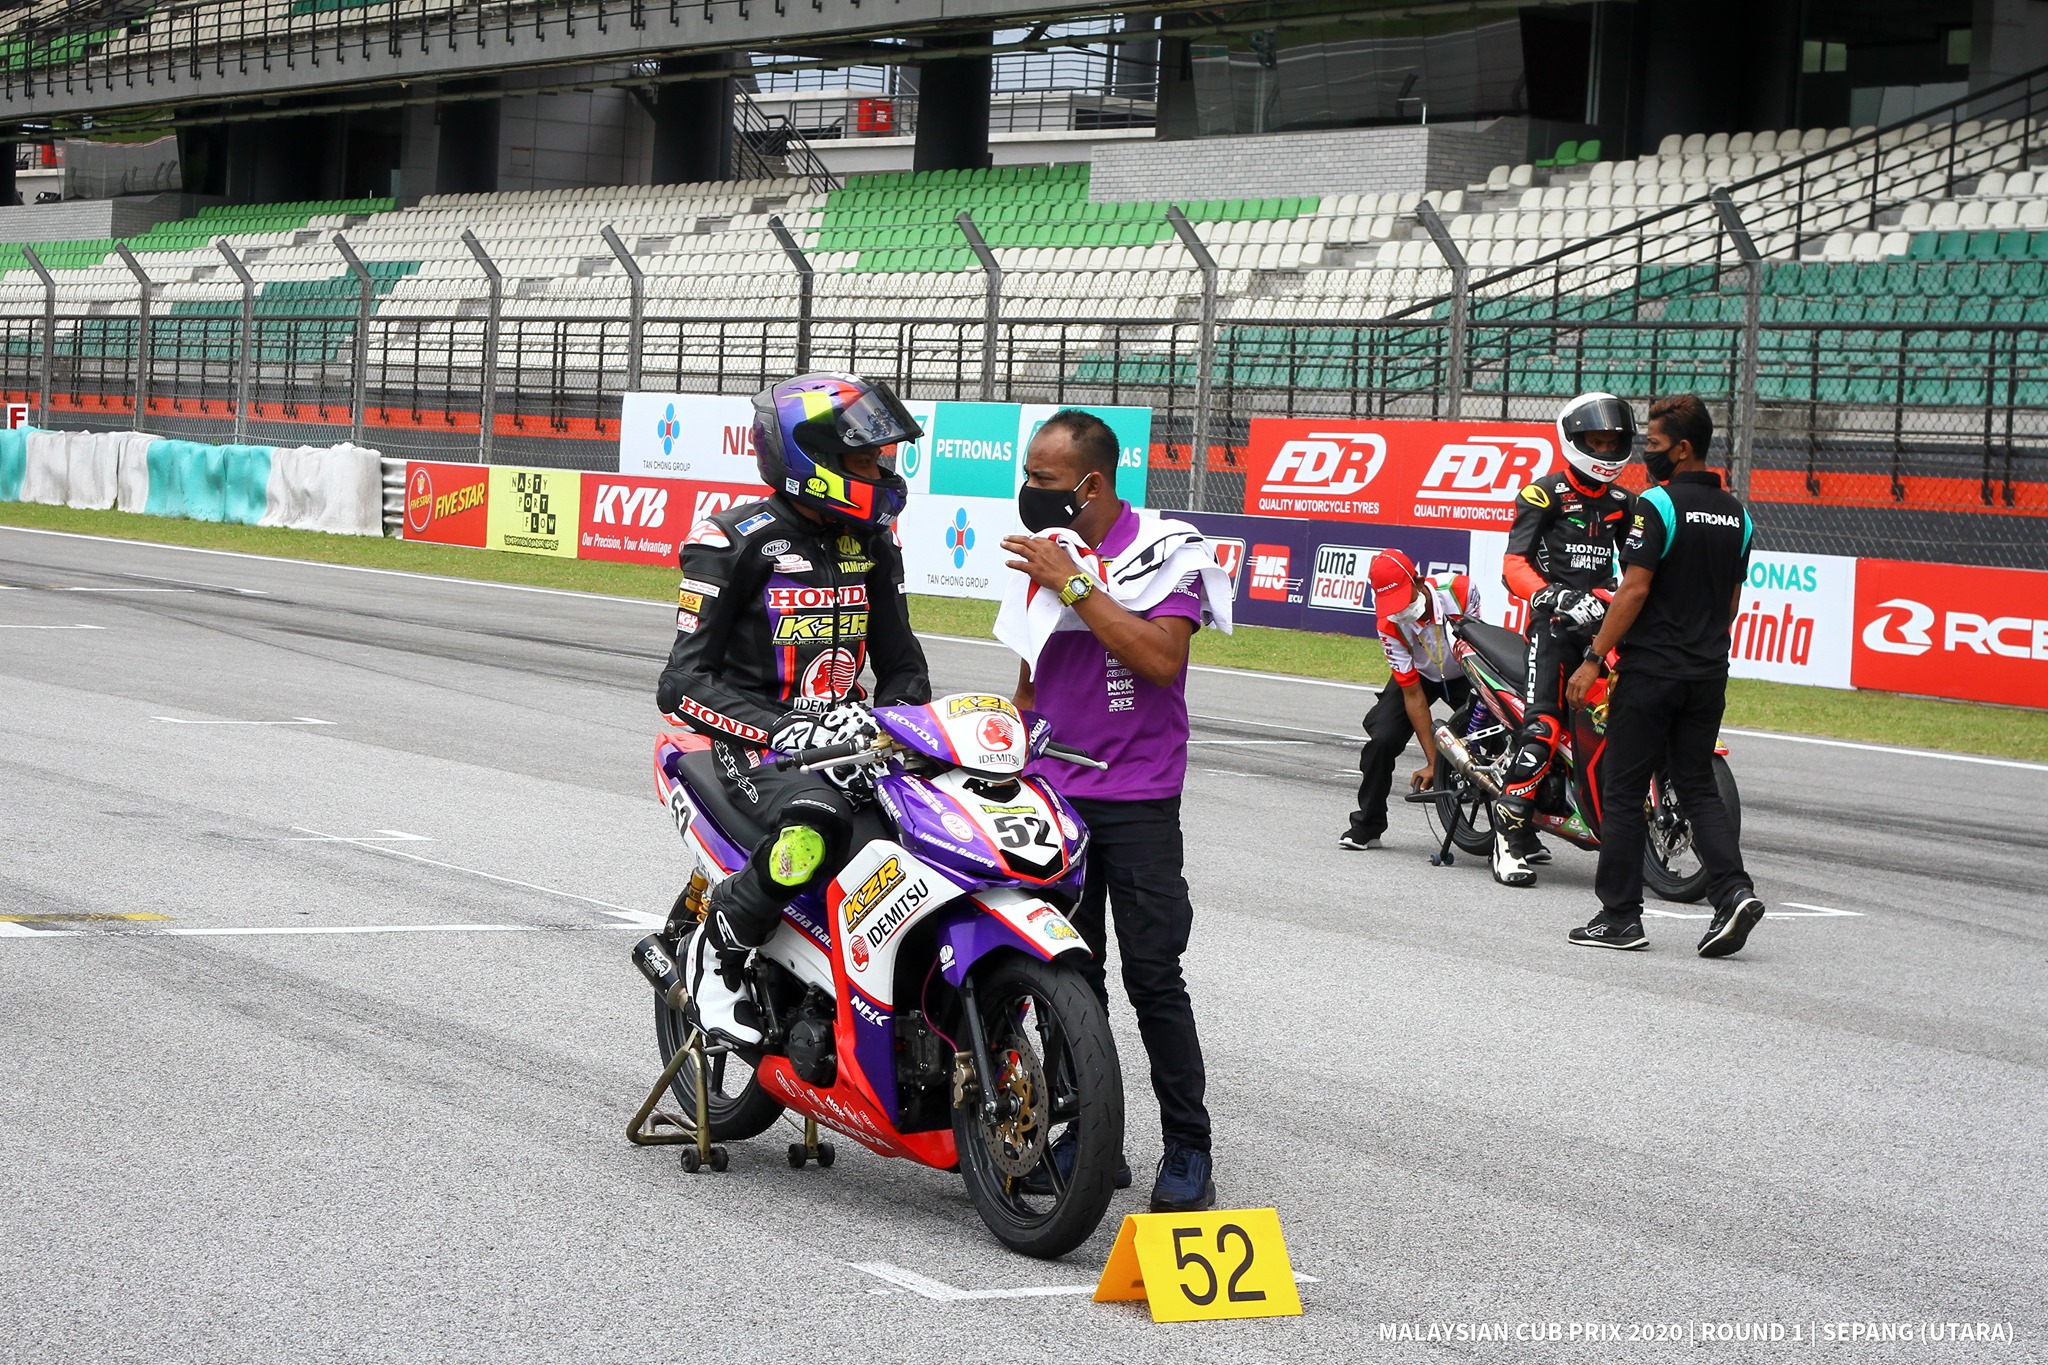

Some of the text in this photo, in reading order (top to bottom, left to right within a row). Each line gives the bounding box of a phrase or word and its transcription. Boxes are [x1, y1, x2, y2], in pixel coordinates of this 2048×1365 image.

[936, 438, 1012, 461] PETRONAS
[643, 460, 690, 472] TAN CHONG GROUP
[1265, 440, 1371, 484] FDR
[511, 476, 548, 490] NASTY
[518, 496, 547, 510] PORT
[592, 484, 668, 528] KYB
[1258, 498, 1380, 514] QUALITY MOTORCYCLE TYRES
[1414, 504, 1514, 521] QUALITY MOTORCYCLE
[525, 516, 556, 532] FLOW
[1686, 512, 1740, 528] PETRONAS
[582, 532, 593, 546] Our
[594, 533, 622, 551] Precision,
[624, 535, 637, 550] Your
[638, 538, 672, 556] Advantage
[1565, 544, 1612, 556] HONDA
[1318, 550, 1357, 576] uma
[927, 574, 988, 588] TAN CHONG GROUP
[1314, 576, 1366, 606] racing
[1377, 582, 1398, 593] HONDA
[771, 587, 868, 606] HOND
[1288, 594, 1304, 604] ECU
[778, 614, 868, 638] KZR
[1526, 633, 1538, 704] TAICHI
[1107, 678, 1134, 692] NGK
[950, 696, 1016, 716] KZR
[885, 710, 939, 752] HONDA
[978, 754, 1020, 766] IDEMITSU
[994, 816, 1059, 849] 52
[920, 832, 996, 868] Honda Racing
[844, 857, 902, 926] KZR
[866, 878, 929, 948] IDEMITSU
[850, 996, 890, 1026] NHK
[826, 1095, 846, 1118] NGK
[811, 1108, 895, 1150] HONDA
[1172, 1224, 1266, 1306] 52
